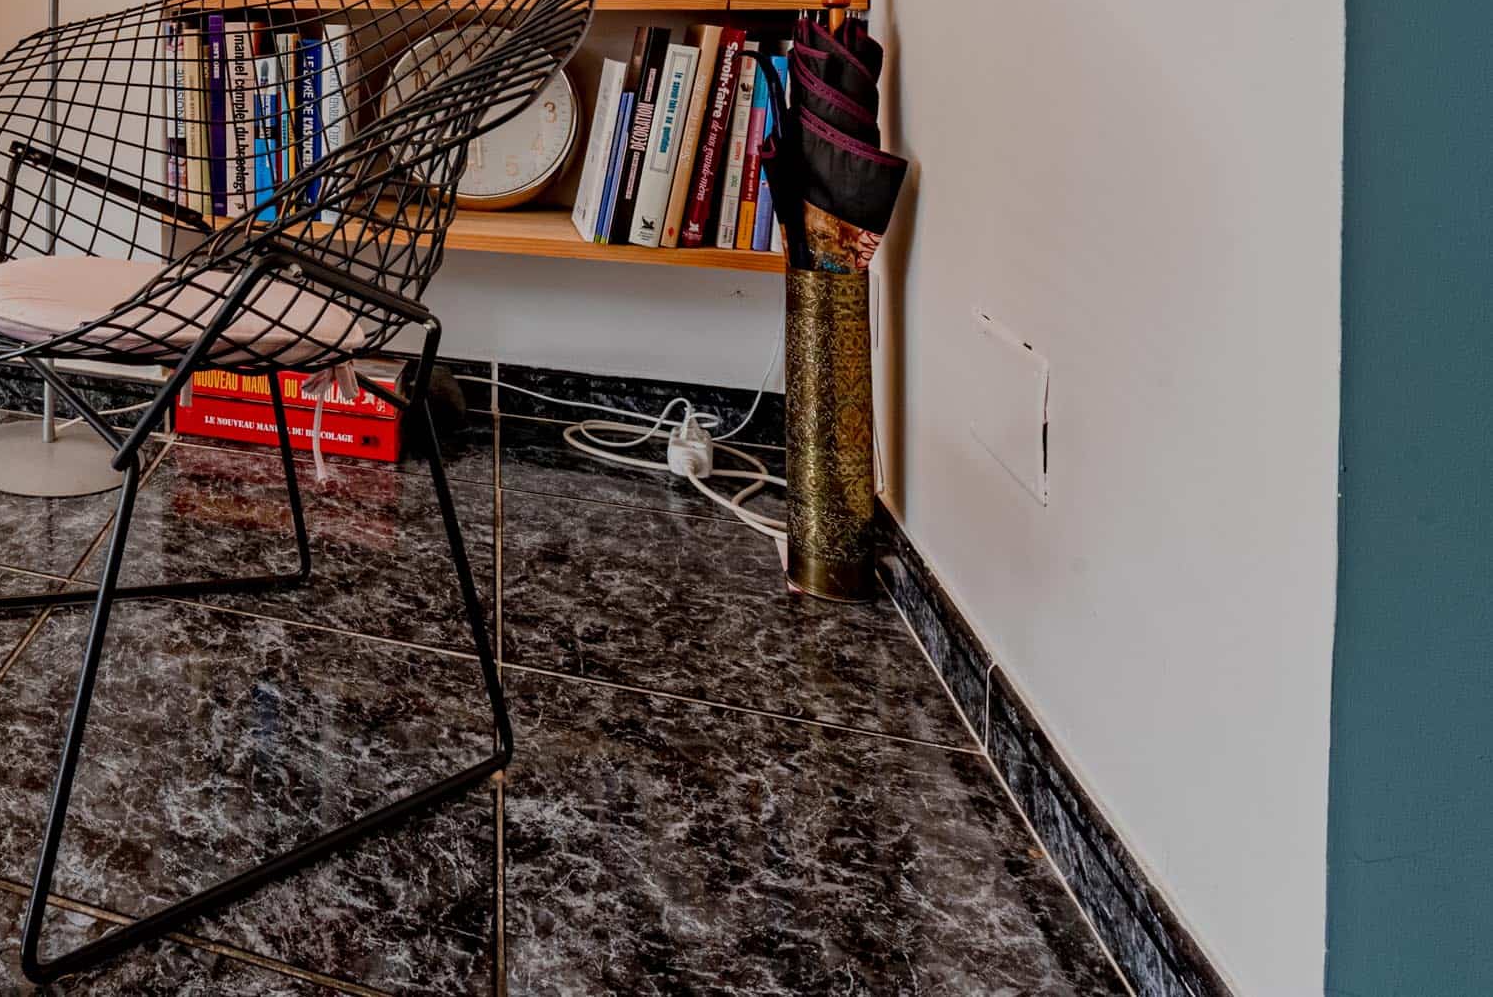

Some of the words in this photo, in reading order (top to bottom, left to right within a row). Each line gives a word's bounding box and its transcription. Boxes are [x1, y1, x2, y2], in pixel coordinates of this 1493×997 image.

[233, 34, 248, 76] manuel
[712, 41, 738, 119] Savoir-faire
[232, 84, 249, 124] complet
[543, 102, 558, 125] 3
[234, 126, 249, 141] du
[712, 119, 722, 131] de
[193, 370, 239, 393] NOUVEAU
[241, 374, 272, 396] MANU
[283, 379, 298, 400] DU
[204, 415, 214, 425] LE
[216, 417, 255, 431] NOUVEAU
[292, 427, 304, 437] DU
